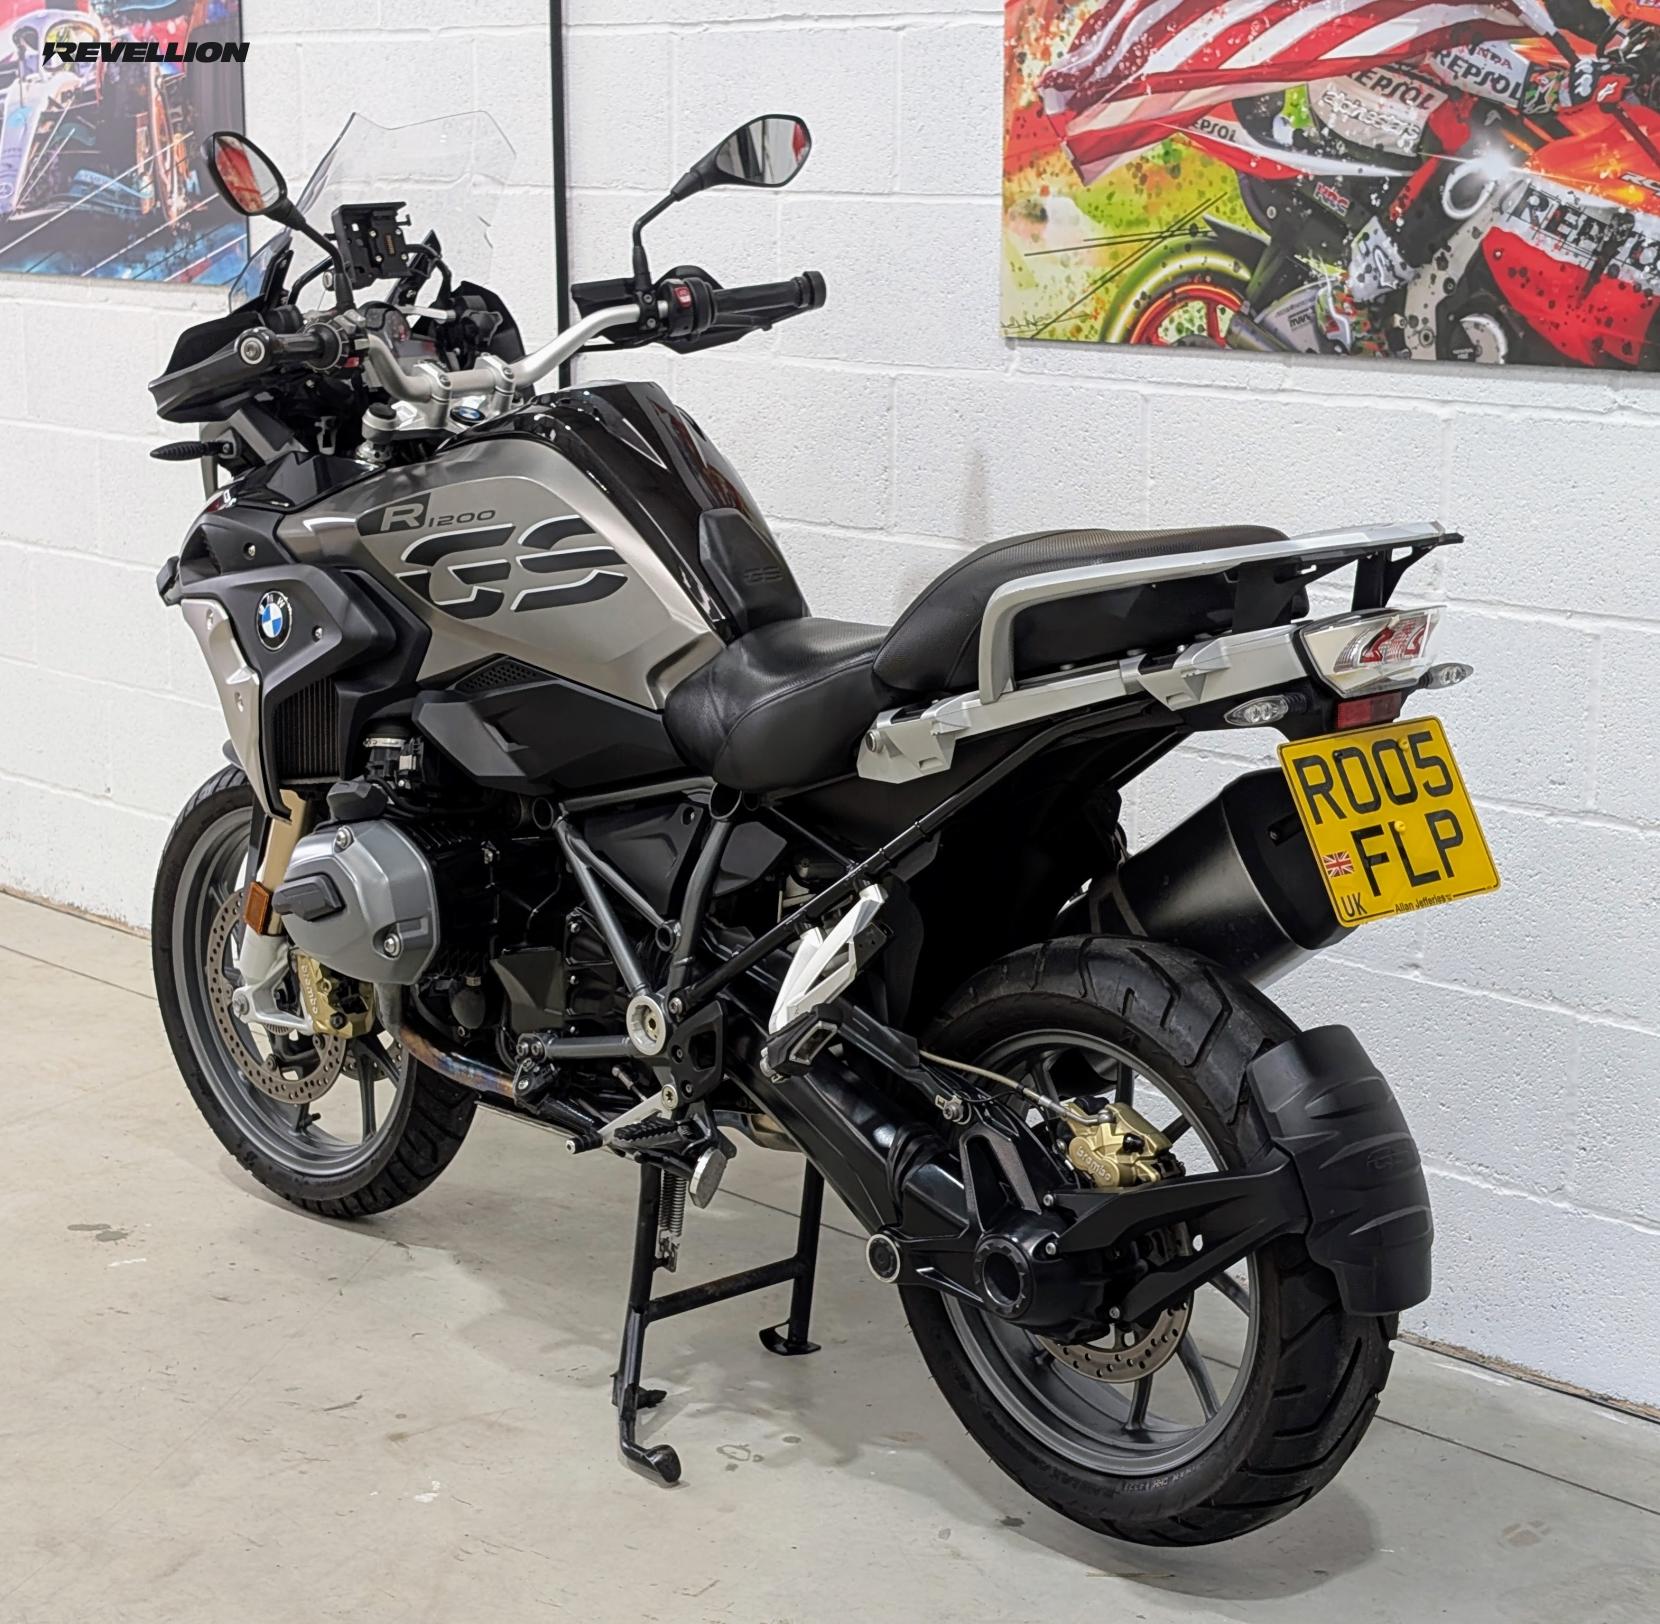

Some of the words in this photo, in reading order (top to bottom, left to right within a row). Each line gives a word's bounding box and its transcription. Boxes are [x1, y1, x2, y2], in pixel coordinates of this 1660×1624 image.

[396, 514, 628, 620] GS
[1292, 731, 1453, 825] RO05
[1351, 809, 1464, 897] FLP
[1341, 891, 1368, 917] UK
[1395, 902, 1415, 914] Allan
[1075, 1145, 1112, 1182] brembo
